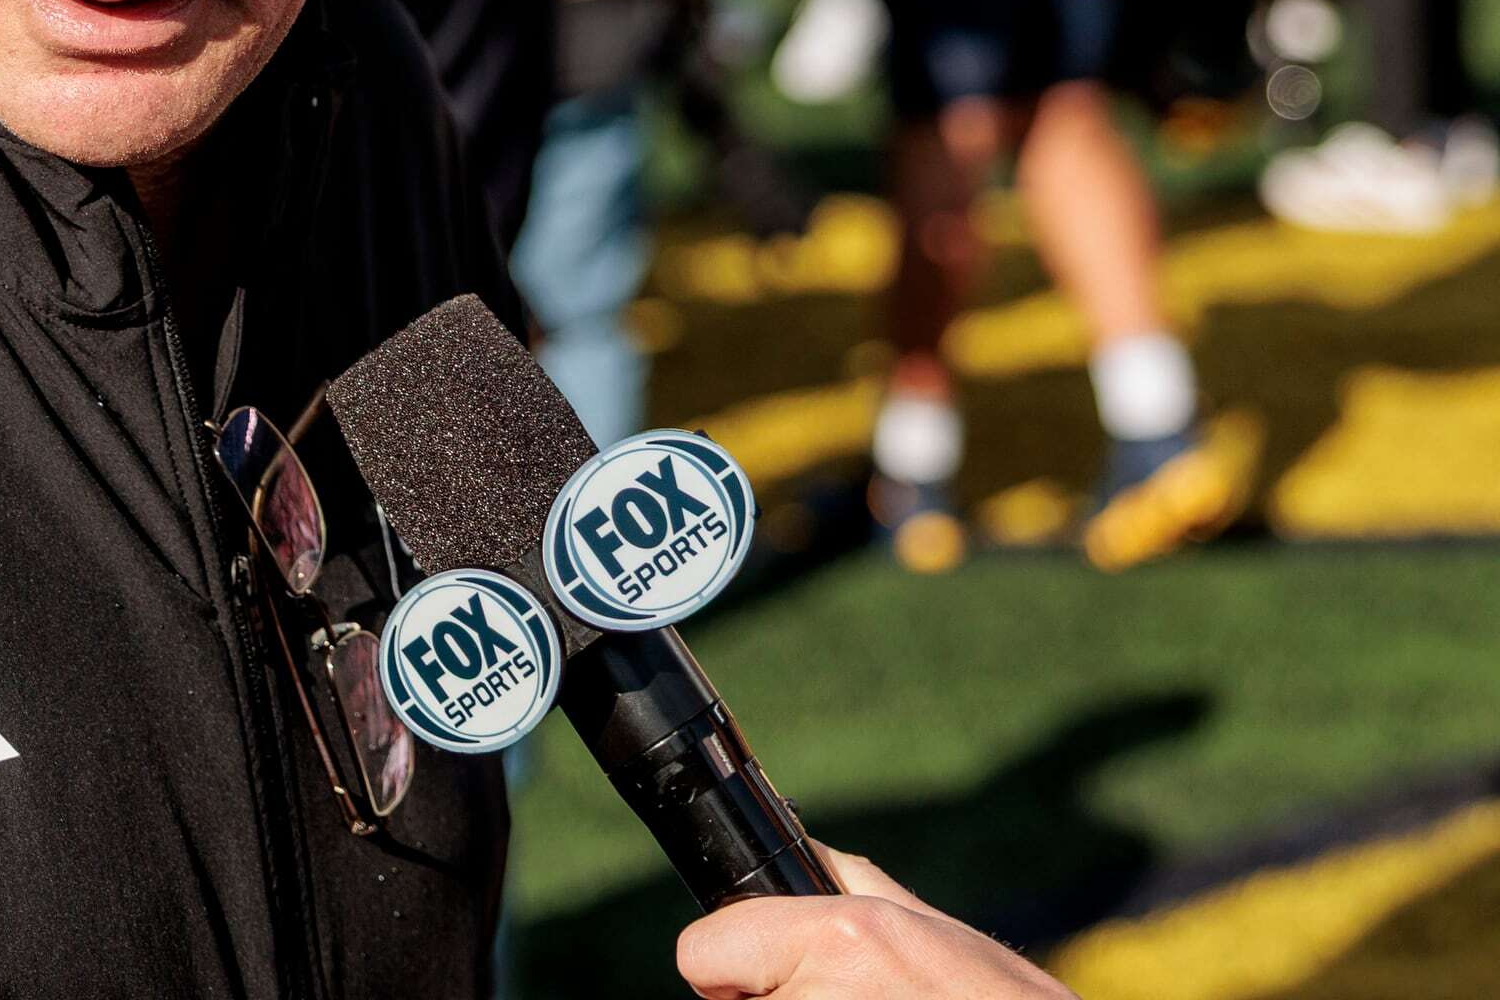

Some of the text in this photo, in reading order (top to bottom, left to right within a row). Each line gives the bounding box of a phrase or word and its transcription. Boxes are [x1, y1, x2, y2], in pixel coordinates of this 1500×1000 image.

[573, 454, 710, 580] FOX
[617, 511, 727, 604] SPORTS
[401, 591, 519, 704] FOX
[444, 650, 536, 728] SPORTS
